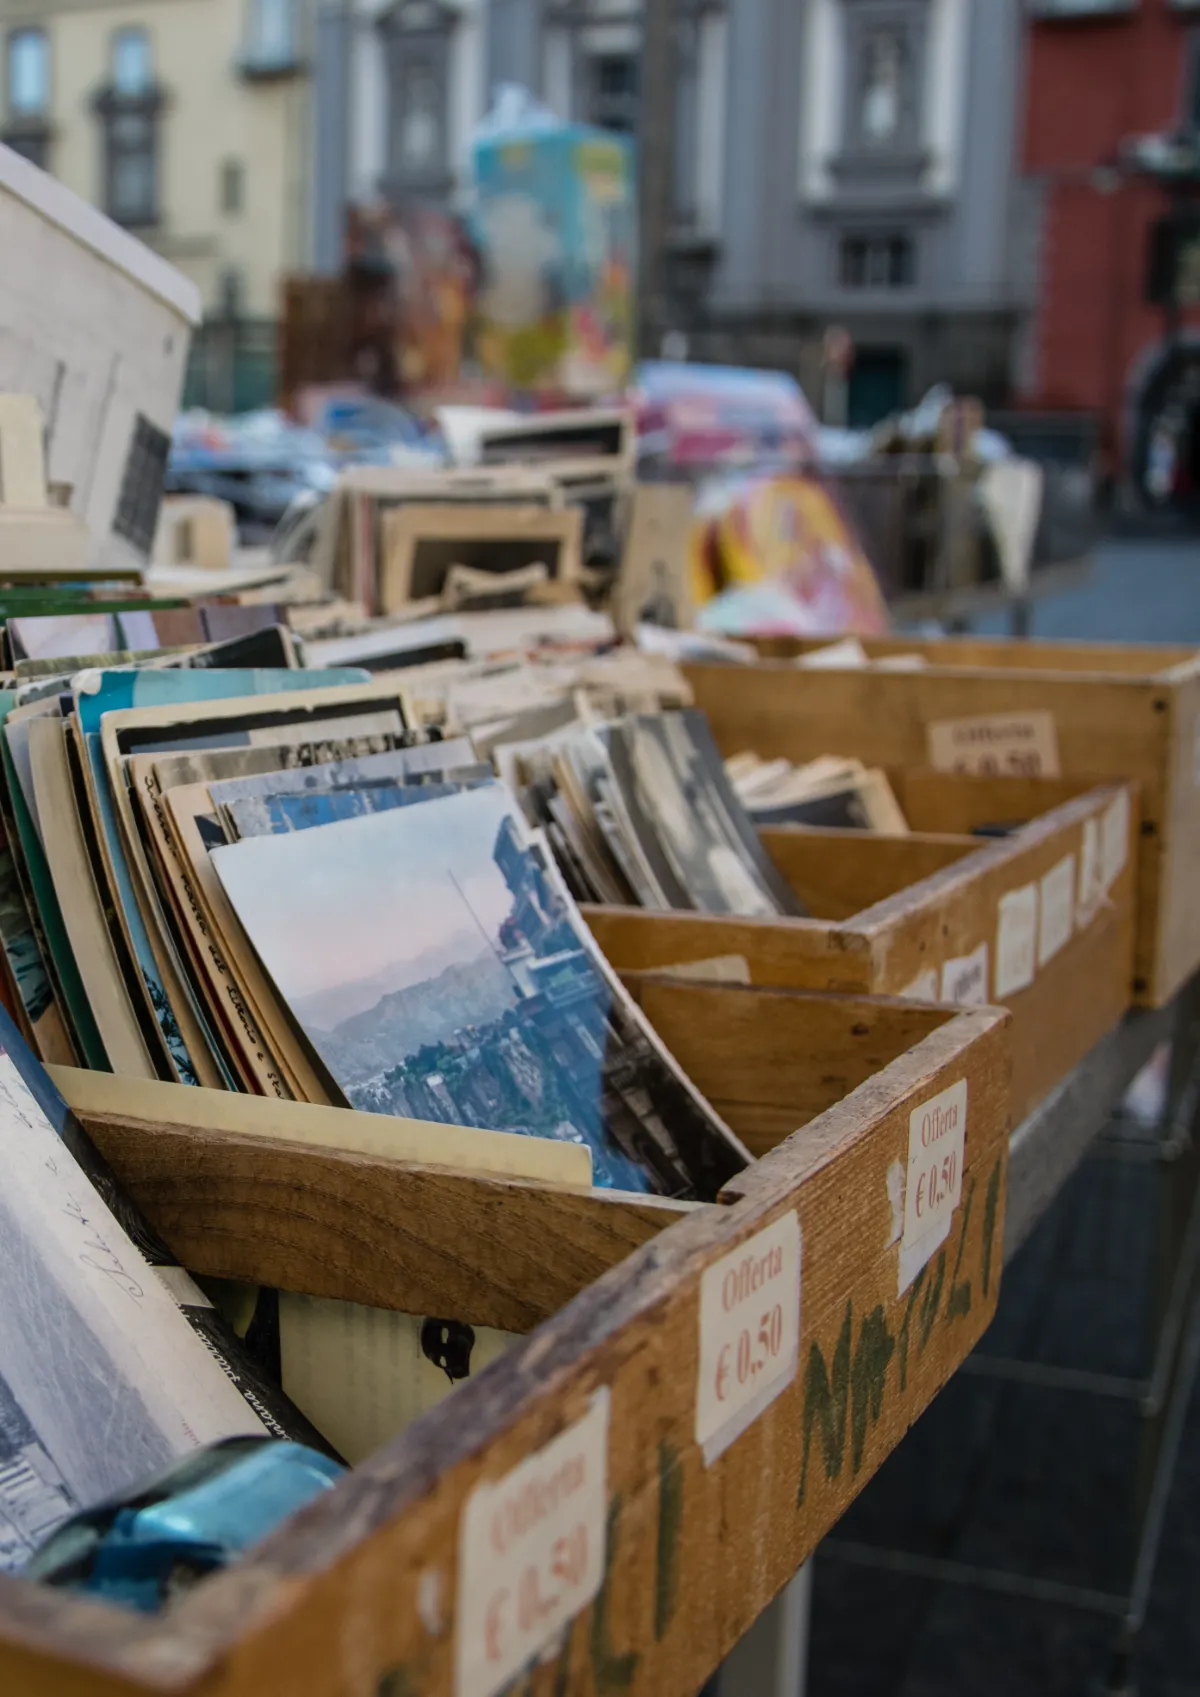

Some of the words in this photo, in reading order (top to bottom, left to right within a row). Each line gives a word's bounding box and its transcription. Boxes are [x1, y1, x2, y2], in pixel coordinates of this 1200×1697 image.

[267, 1072, 285, 1100] Sta
[921, 1103, 958, 1148] Offerta
[915, 1172, 926, 1218] €
[721, 1246, 783, 1312] Offerta
[714, 1343, 732, 1402] €
[244, 1388, 293, 1442] ontana
